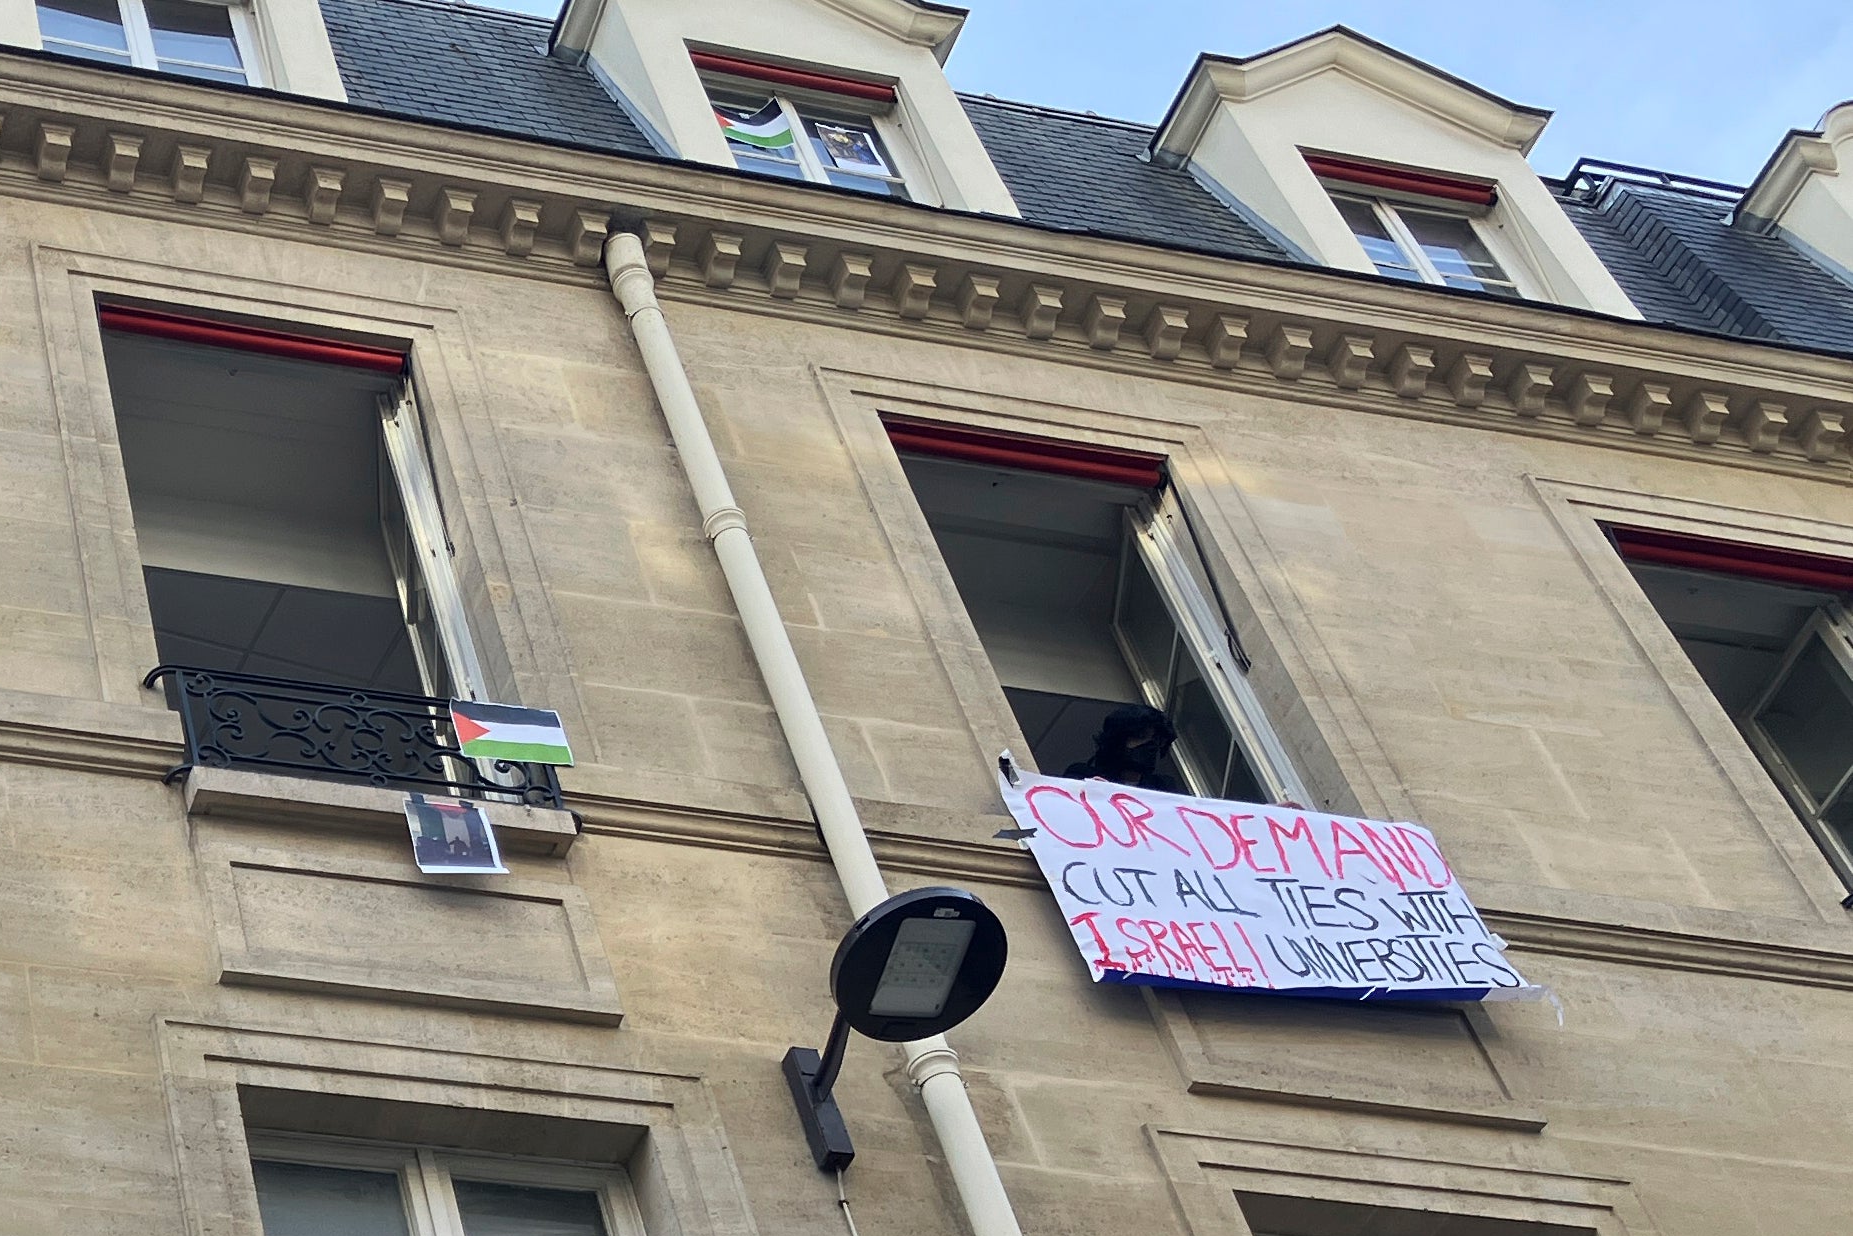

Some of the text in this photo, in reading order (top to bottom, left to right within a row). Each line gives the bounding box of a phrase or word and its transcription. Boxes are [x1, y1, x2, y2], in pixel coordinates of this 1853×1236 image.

[1025, 785, 1453, 892] OUR DEMAND
[1061, 861, 1491, 940] CUT ALL TIES WITH
[1070, 911, 1271, 986] ISRAELI
